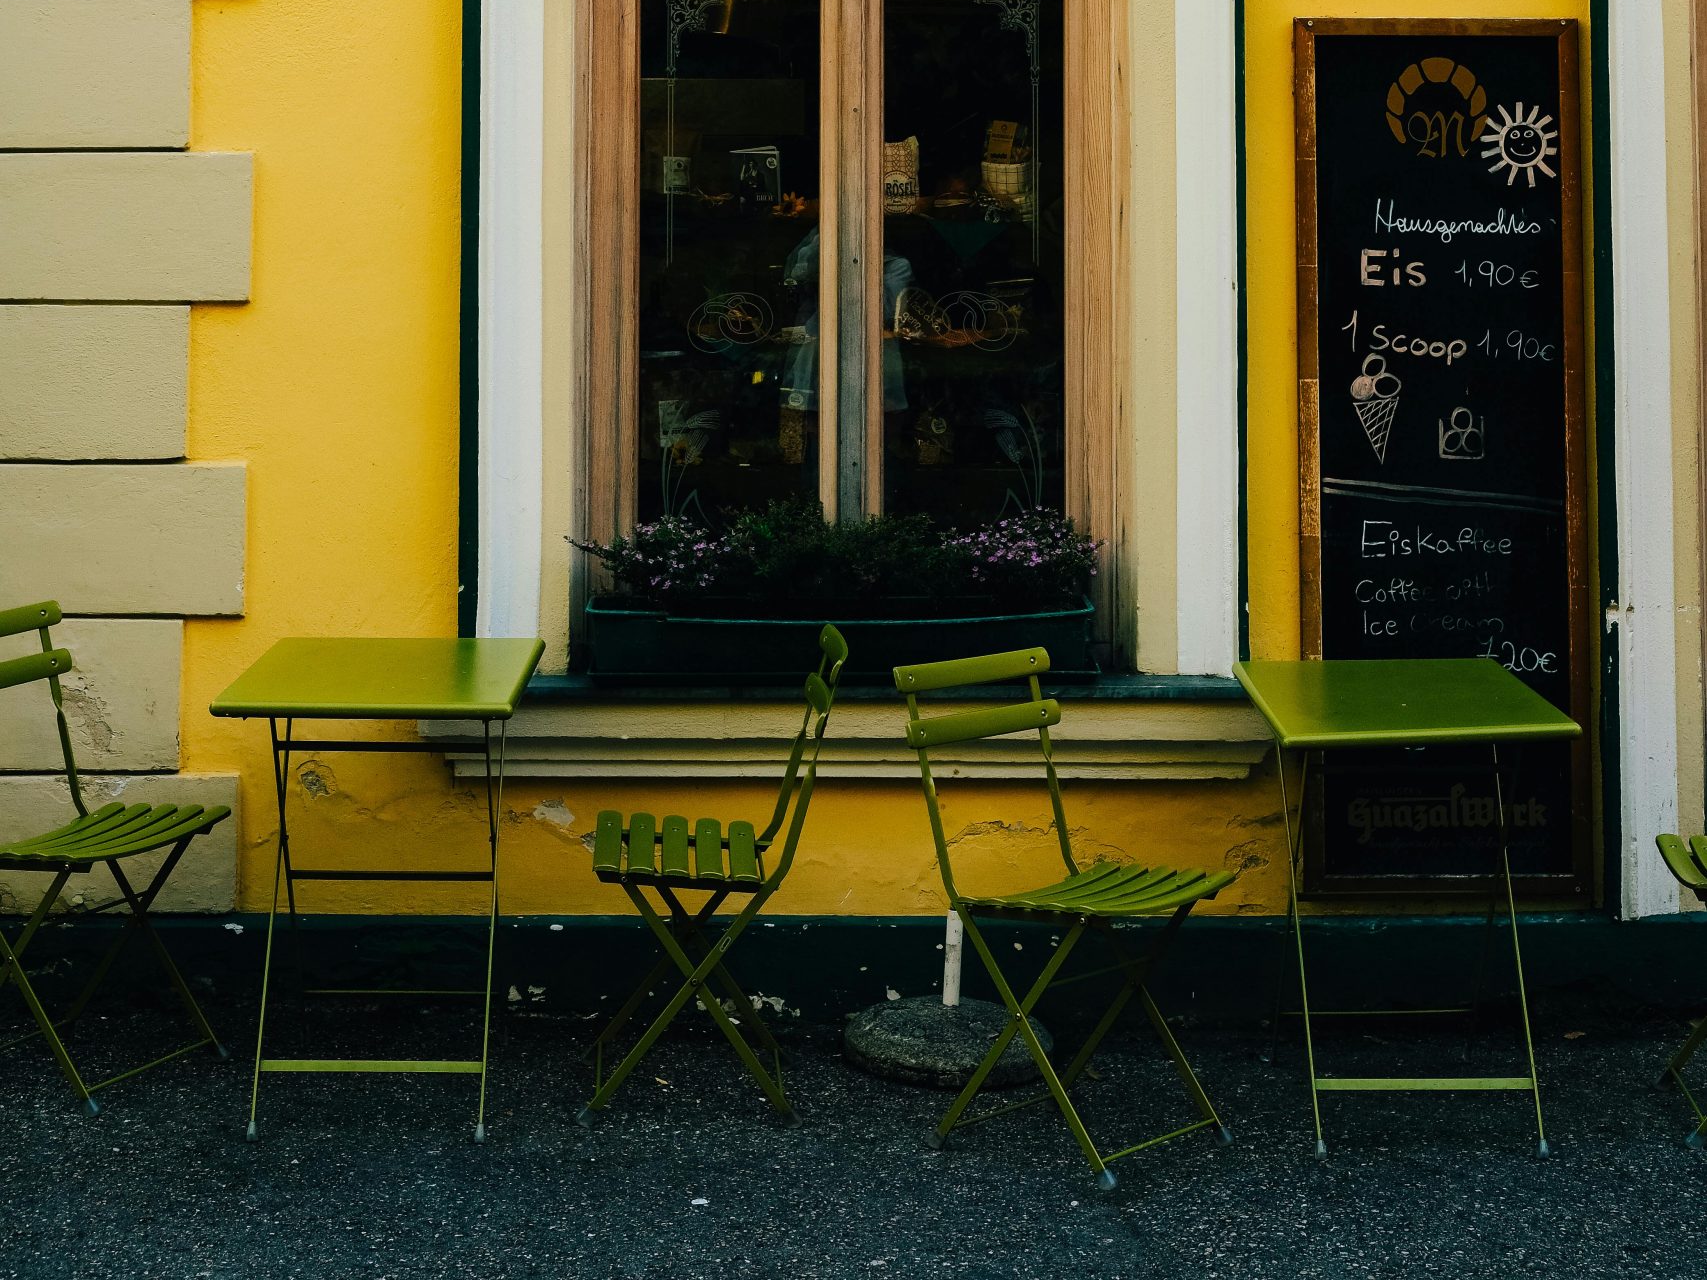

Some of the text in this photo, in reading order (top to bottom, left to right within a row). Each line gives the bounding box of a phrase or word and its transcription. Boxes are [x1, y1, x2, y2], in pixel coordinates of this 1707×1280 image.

[1374, 198, 1541, 243] Hausgemachtes
[1360, 248, 1427, 287] Eis
[1341, 310, 1358, 352] 1
[1363, 609, 1399, 636] Ice
